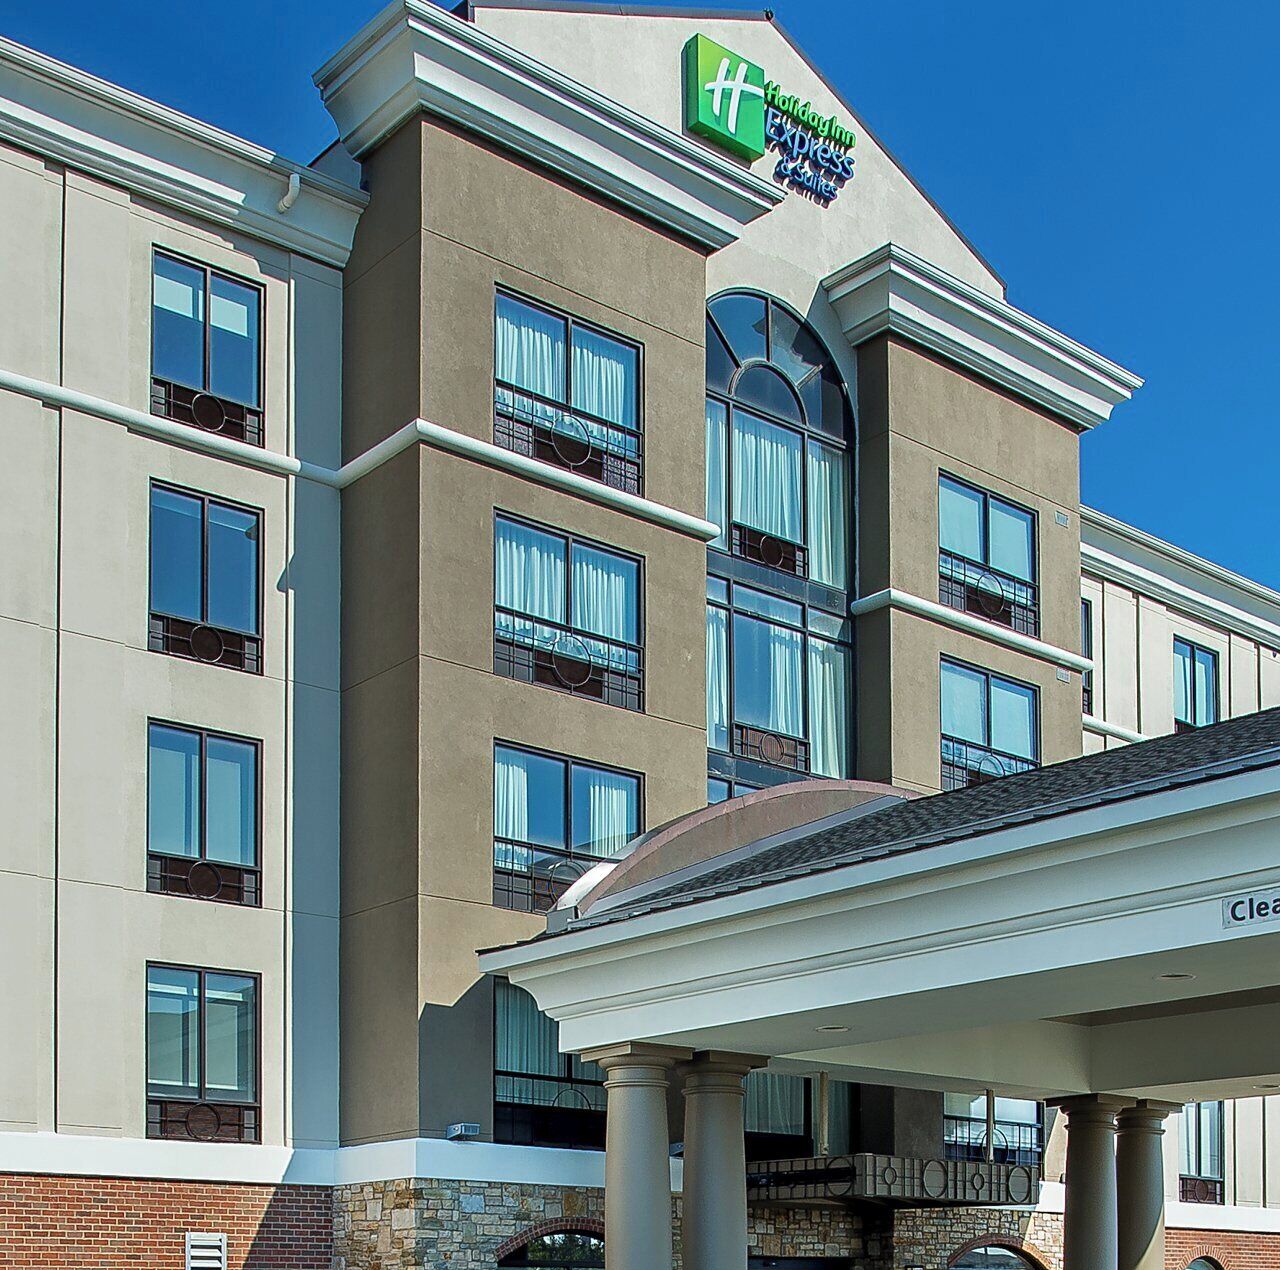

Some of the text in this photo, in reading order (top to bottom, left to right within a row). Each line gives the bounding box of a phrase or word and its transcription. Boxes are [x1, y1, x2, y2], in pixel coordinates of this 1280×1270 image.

[765, 80, 856, 148] Holiday Inn
[766, 107, 855, 182] Express
[780, 157, 839, 200] & Suites
